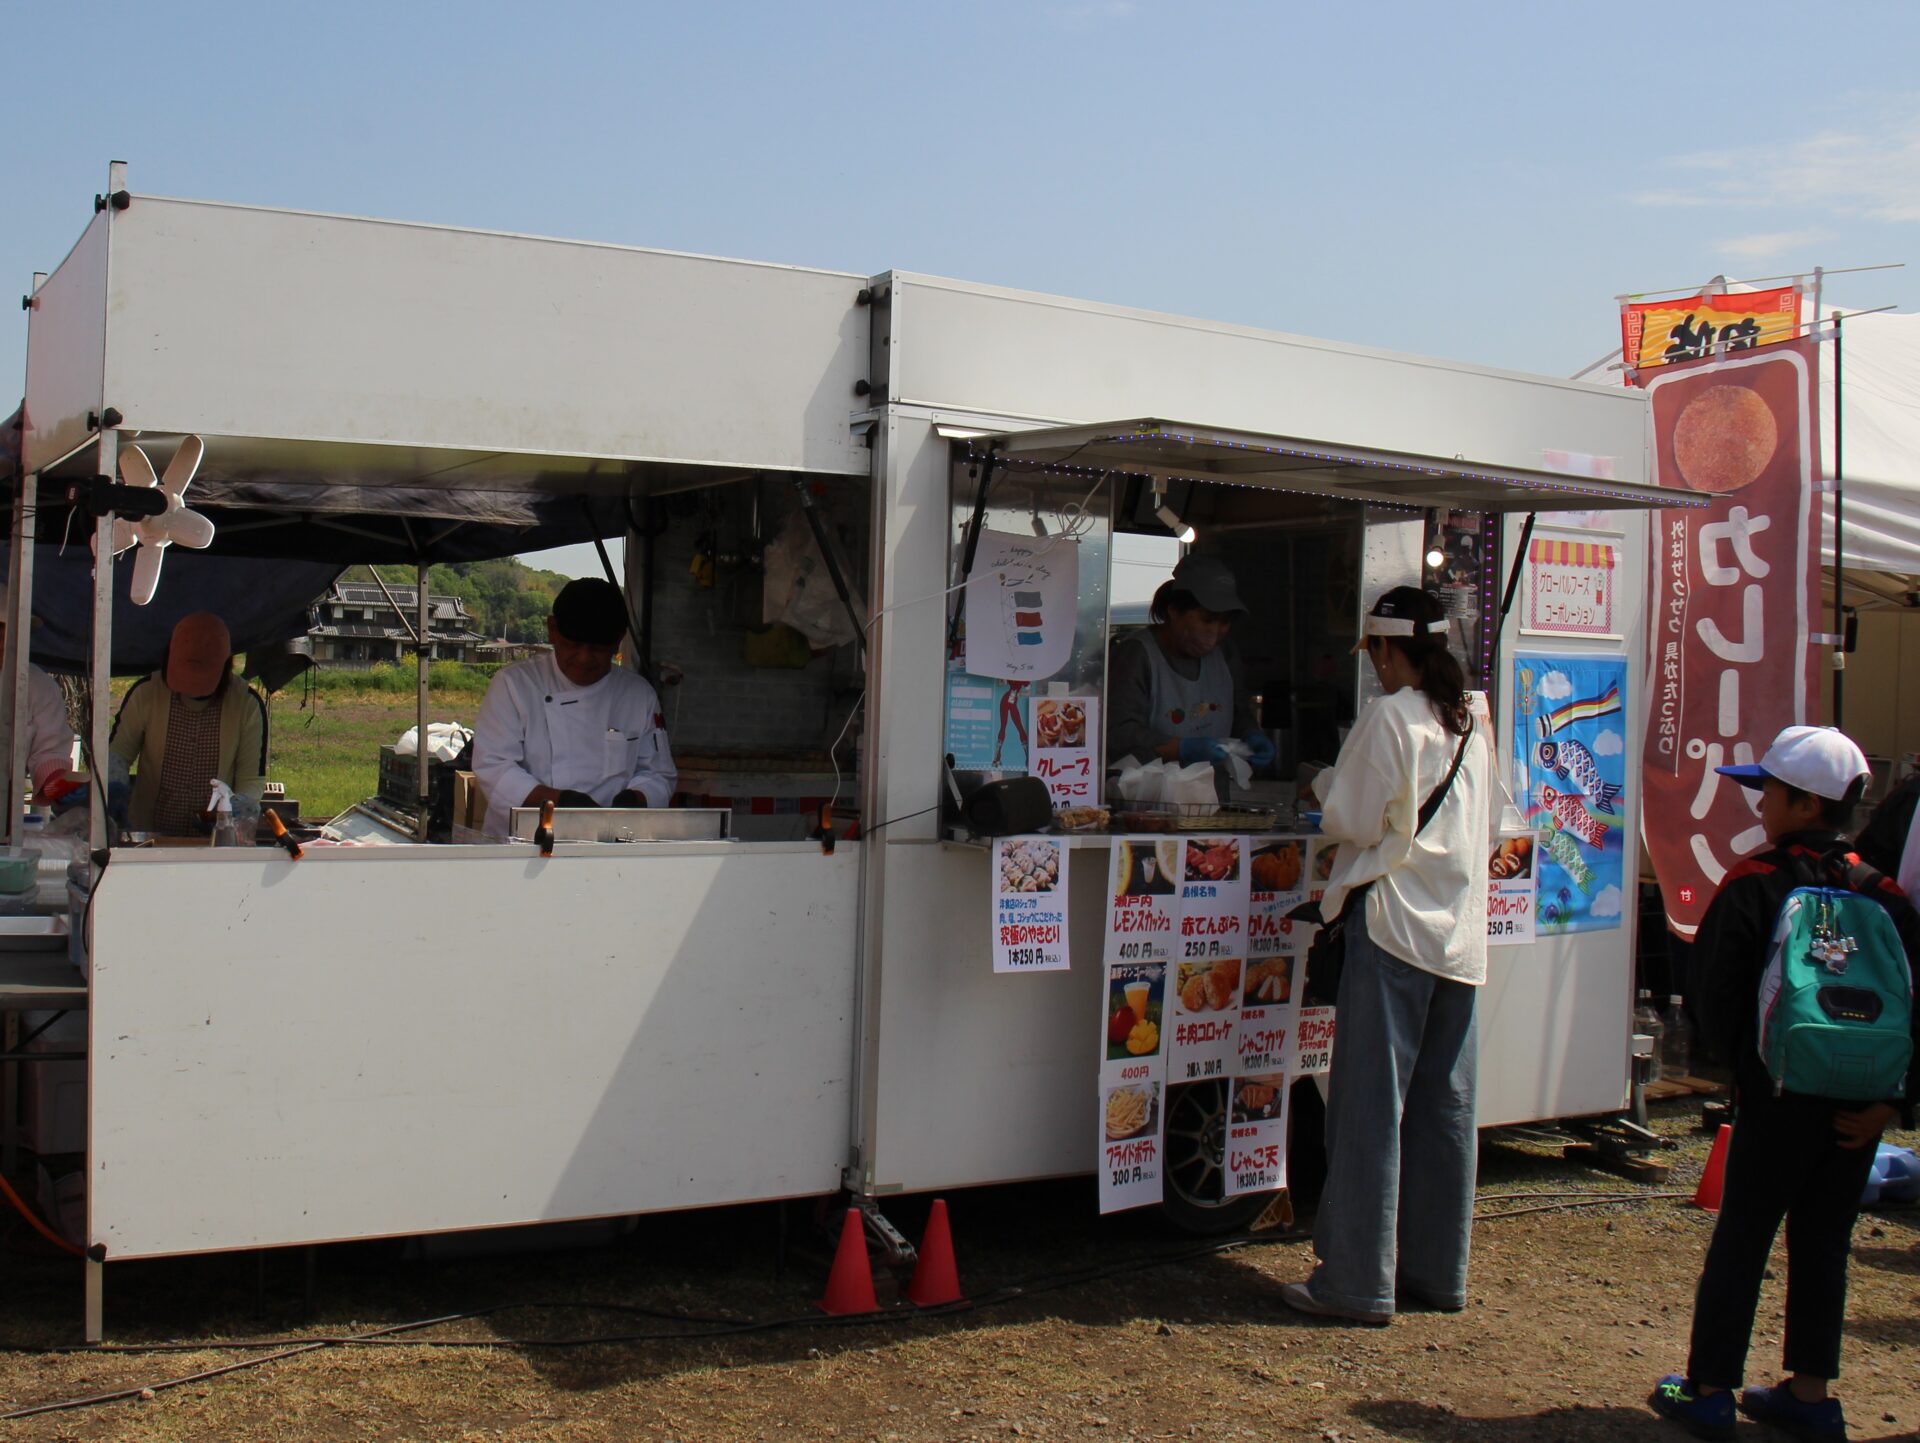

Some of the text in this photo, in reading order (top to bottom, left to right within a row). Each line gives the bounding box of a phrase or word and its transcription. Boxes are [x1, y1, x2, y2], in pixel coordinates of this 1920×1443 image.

[1540, 572, 1590, 595] グローバルフーズ
[1545, 602, 1595, 625] コーポレーション
[1037, 757, 1090, 777] クレープ
[1114, 895, 1152, 908] 瀬戸内
[1114, 909, 1171, 933] レモンスカッシュ
[1181, 916, 1240, 937] 赤てんぷら
[1000, 925, 1060, 946] 究極のやきとり
[1176, 1019, 1232, 1046] 牛肉コロッケ
[1238, 1029, 1286, 1055] じゃこカツ
[1121, 1066, 1149, 1080] 400円
[1106, 1139, 1156, 1169] フライドポテト
[1230, 1145, 1279, 1173] じゃこ天
